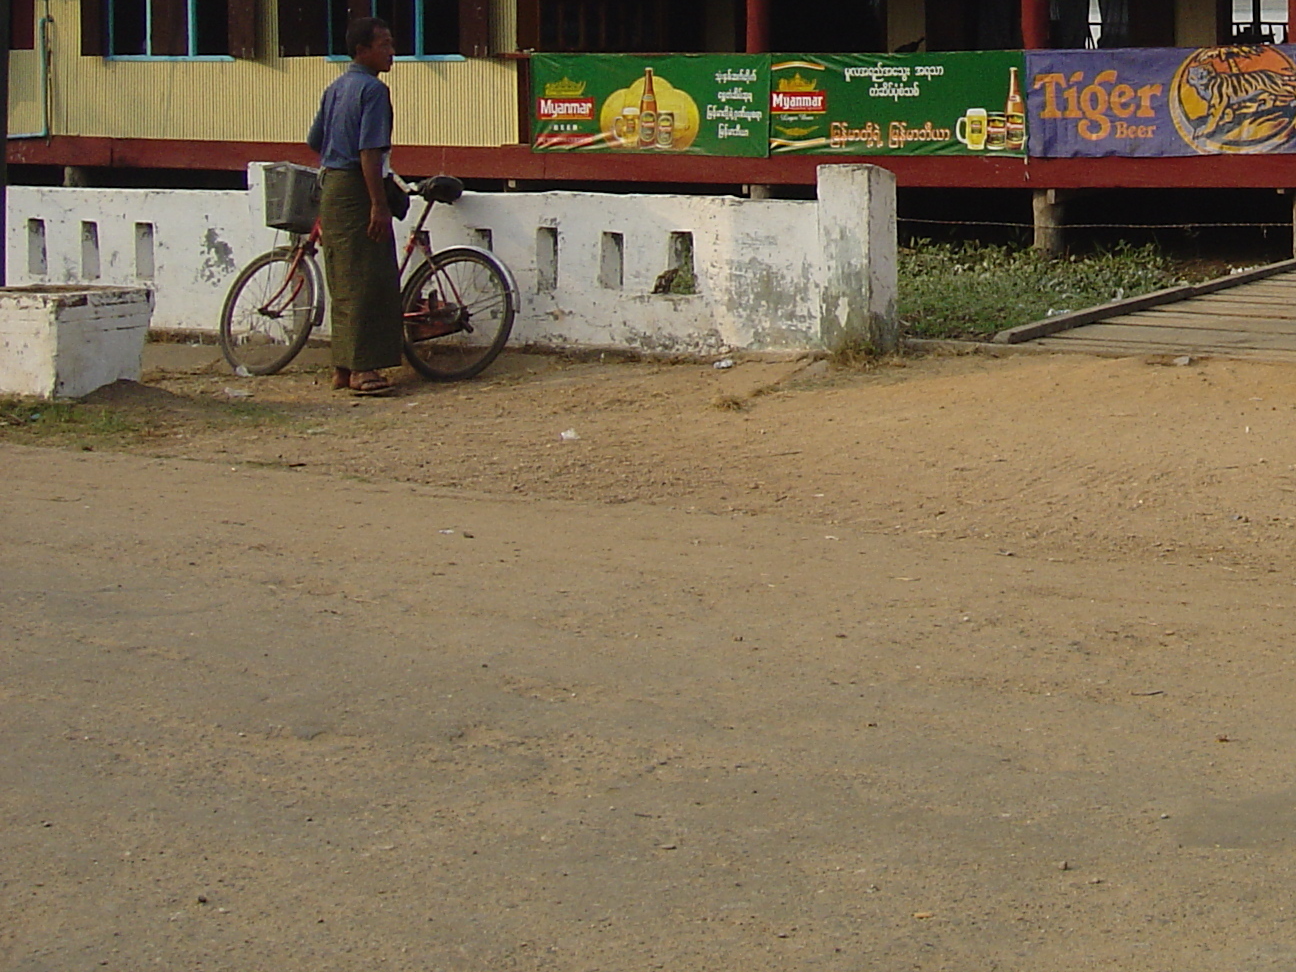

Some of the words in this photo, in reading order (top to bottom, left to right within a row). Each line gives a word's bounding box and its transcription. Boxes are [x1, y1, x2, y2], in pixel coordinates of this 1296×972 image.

[540, 99, 592, 117] Myanmar
[772, 93, 824, 110] Myanmar
[1033, 70, 1162, 141] Tiger
[1114, 120, 1156, 139] Beer
